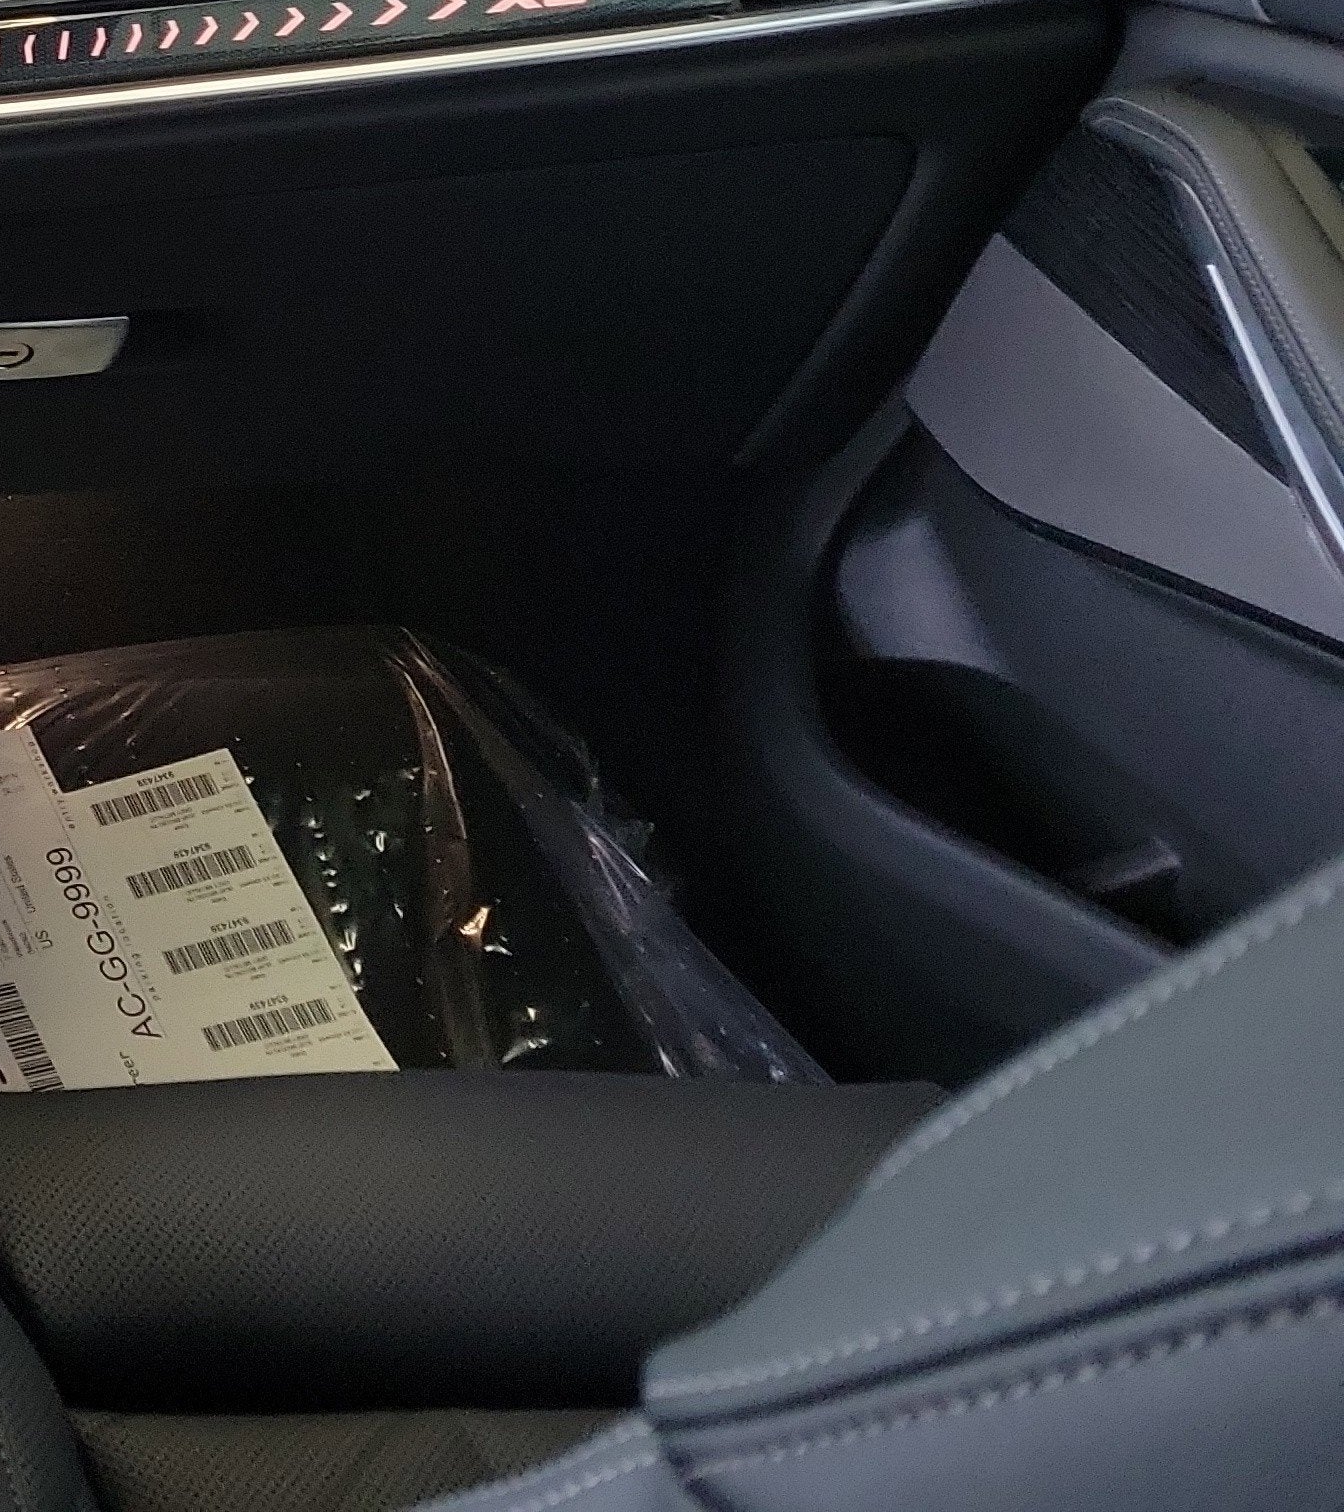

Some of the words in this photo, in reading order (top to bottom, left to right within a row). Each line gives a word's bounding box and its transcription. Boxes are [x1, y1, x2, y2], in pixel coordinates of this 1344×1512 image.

[4, 855, 22, 883] States
[16, 885, 36, 913] United
[35, 930, 53, 949] US
[47, 848, 159, 1036] AC-GG-9999
